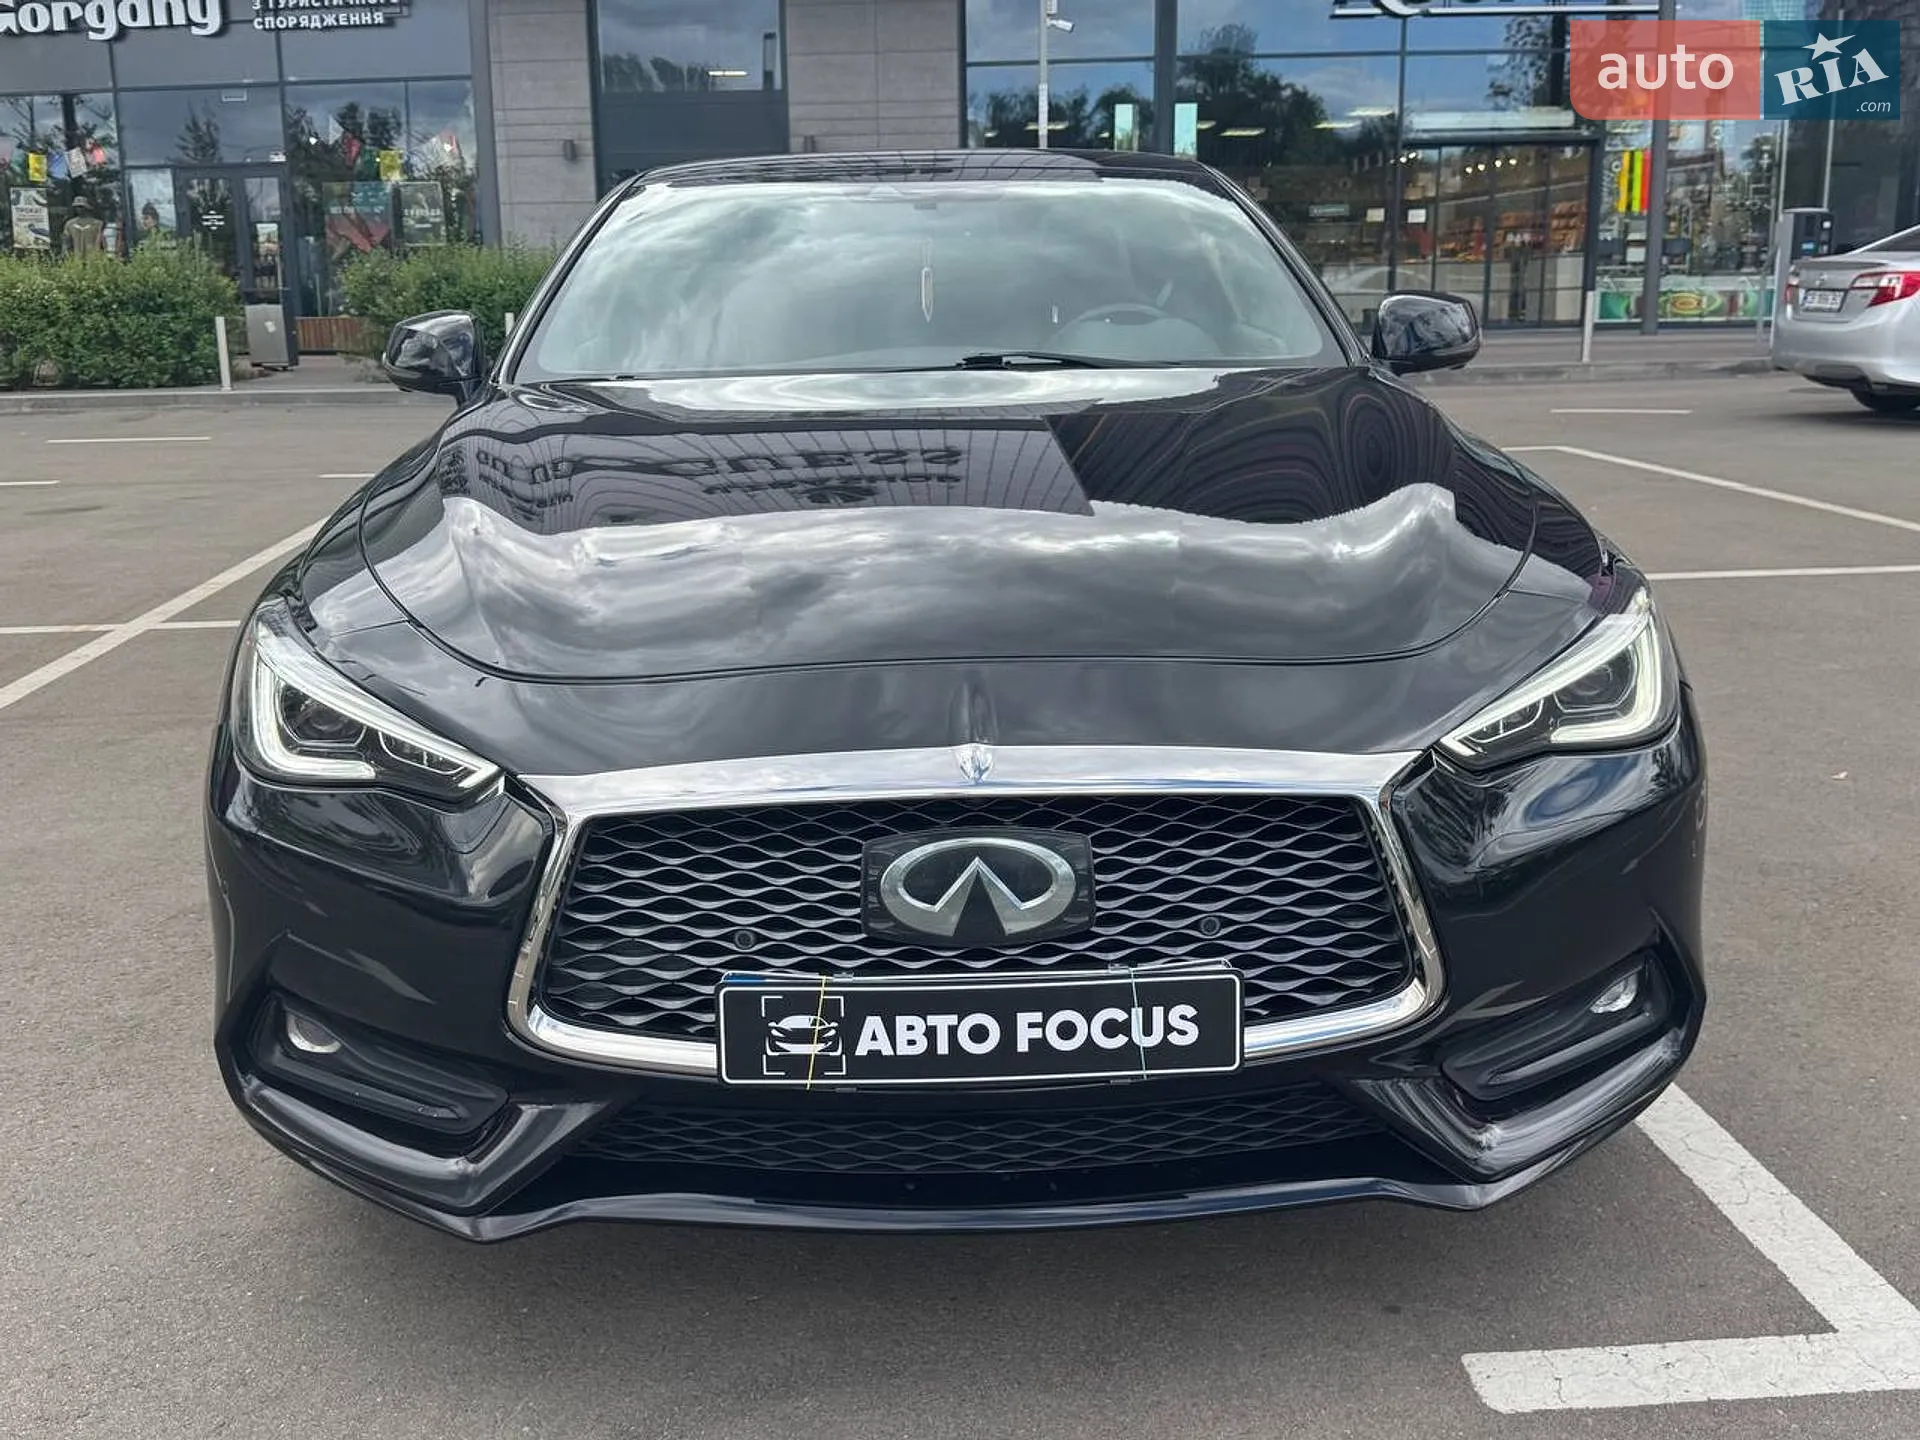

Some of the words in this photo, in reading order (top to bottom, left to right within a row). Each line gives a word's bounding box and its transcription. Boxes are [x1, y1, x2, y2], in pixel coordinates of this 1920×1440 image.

[253, 11, 385, 30] СПОРЯДЖЕННЯ
[855, 1012, 1000, 1057] АВТО
[1015, 1004, 1199, 1052] FOCUS
